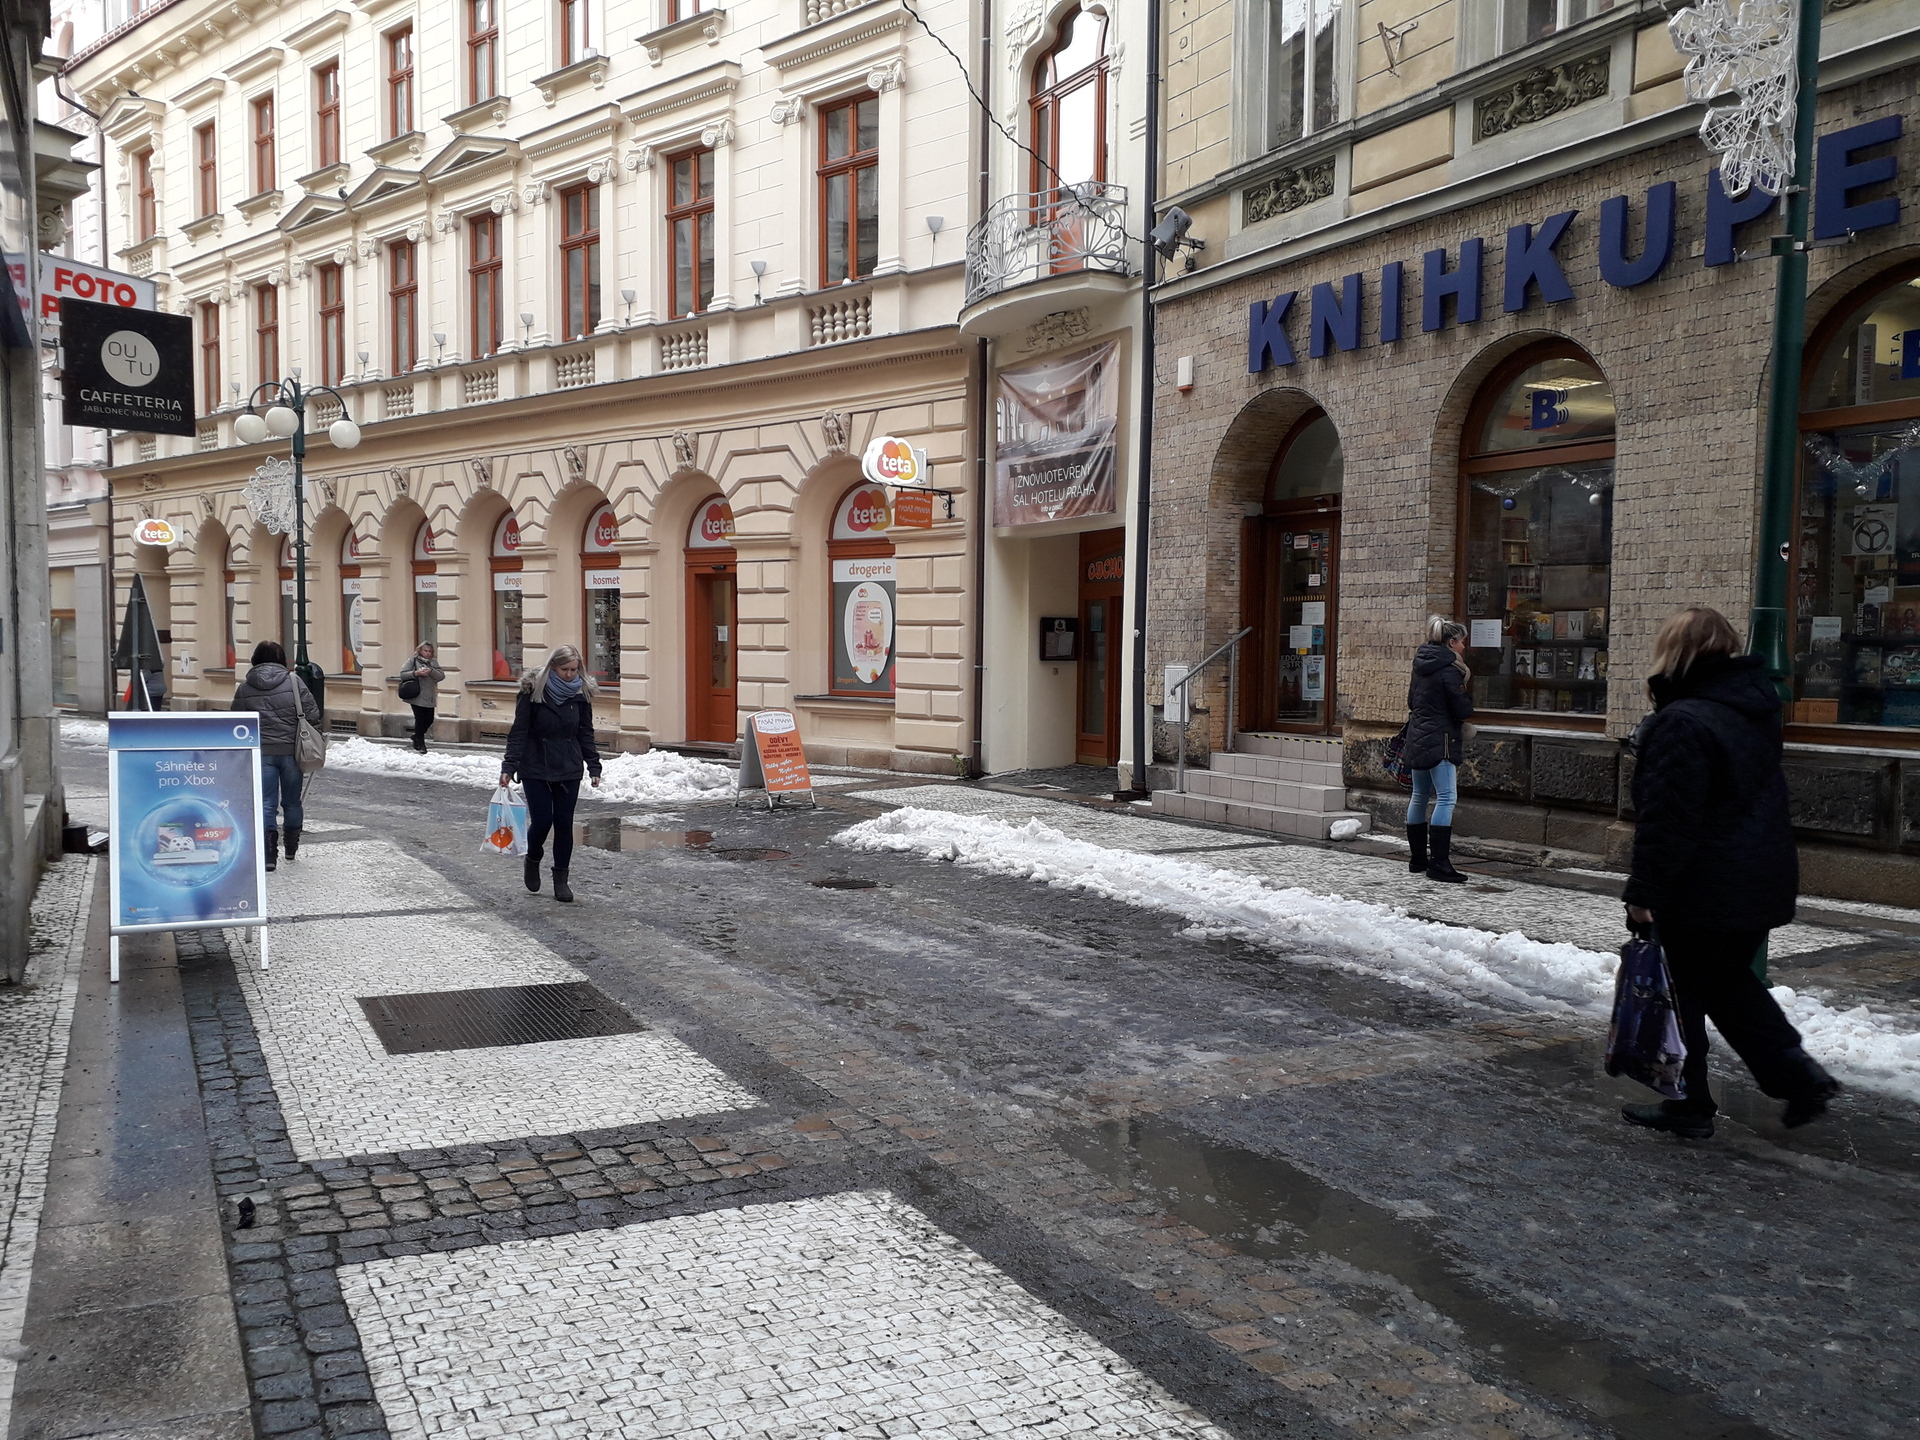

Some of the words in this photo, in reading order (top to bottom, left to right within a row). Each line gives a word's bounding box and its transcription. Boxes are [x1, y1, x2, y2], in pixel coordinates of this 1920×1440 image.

[55, 267, 136, 308] FOTO
[108, 341, 136, 358] OU
[1890, 333, 1900, 381] BETA
[125, 359, 152, 376] TU
[80, 389, 182, 411] CAFFETERIA
[82, 405, 130, 417] JABLONEC
[132, 410, 151, 418] NAD
[154, 412, 182, 421] NISOU
[881, 453, 912, 473] teta
[1013, 491, 1029, 507] SÁL
[1030, 488, 1065, 504] HOTELU
[1066, 482, 1096, 499] PRAHA
[853, 506, 887, 524] teta
[144, 529, 170, 539] teta
[705, 518, 735, 534] teta
[849, 561, 892, 578] drogerie
[769, 736, 788, 744] ODĚVY
[155, 761, 205, 772] Sáhněte
[208, 760, 217, 771] si
[158, 777, 180, 788] pro
[184, 774, 215, 786] Xbox
[204, 830, 219, 838] 495
